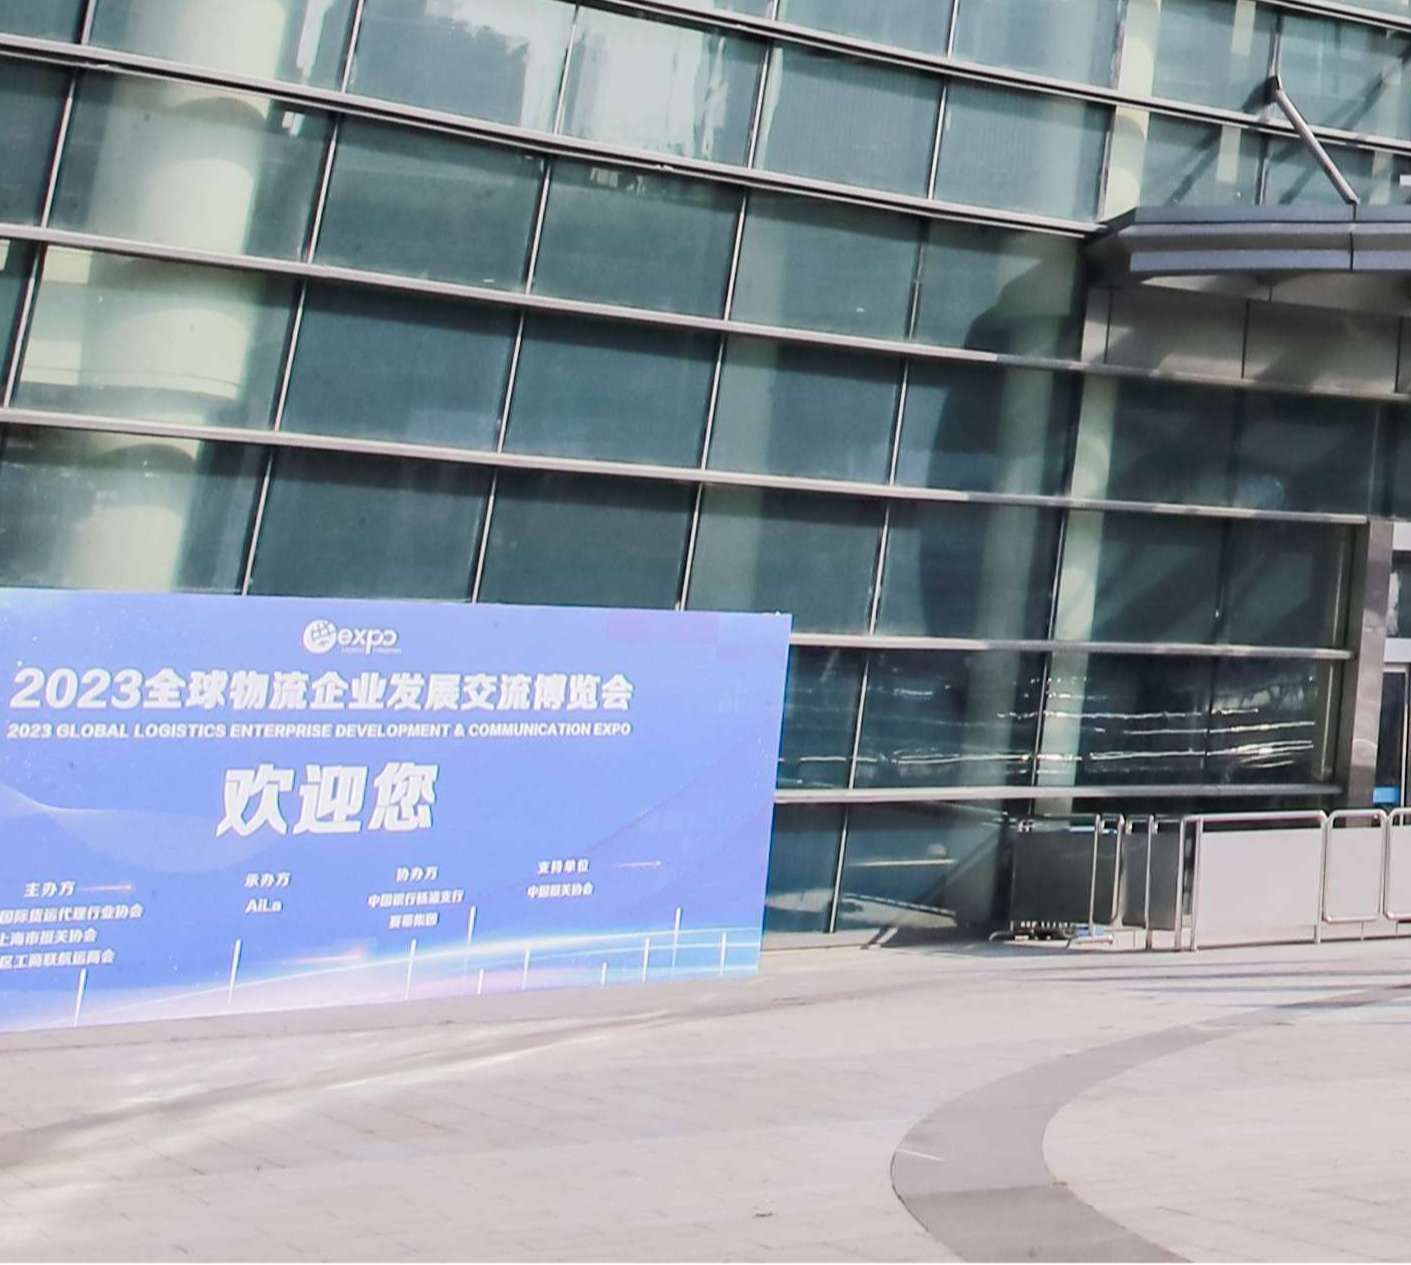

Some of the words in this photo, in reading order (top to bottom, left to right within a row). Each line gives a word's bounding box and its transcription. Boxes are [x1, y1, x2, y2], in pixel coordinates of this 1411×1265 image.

[9, 667, 634, 711] 2023全球物流企业发展交流博览会
[8, 723, 52, 738] 2023
[56, 723, 127, 738] GLOBAL
[134, 723, 226, 738] LOGISTICS
[230, 723, 332, 737] ENTERPRISE
[335, 722, 450, 737] DEVELOPMENT
[453, 723, 465, 736] &
[469, 722, 592, 736] COMMUNICATION
[594, 722, 631, 735] EXPO
[216, 762, 438, 836] 欢迎您
[244, 872, 291, 888] 承办方
[395, 866, 438, 881] 协办方
[24, 880, 76, 898] 主办方
